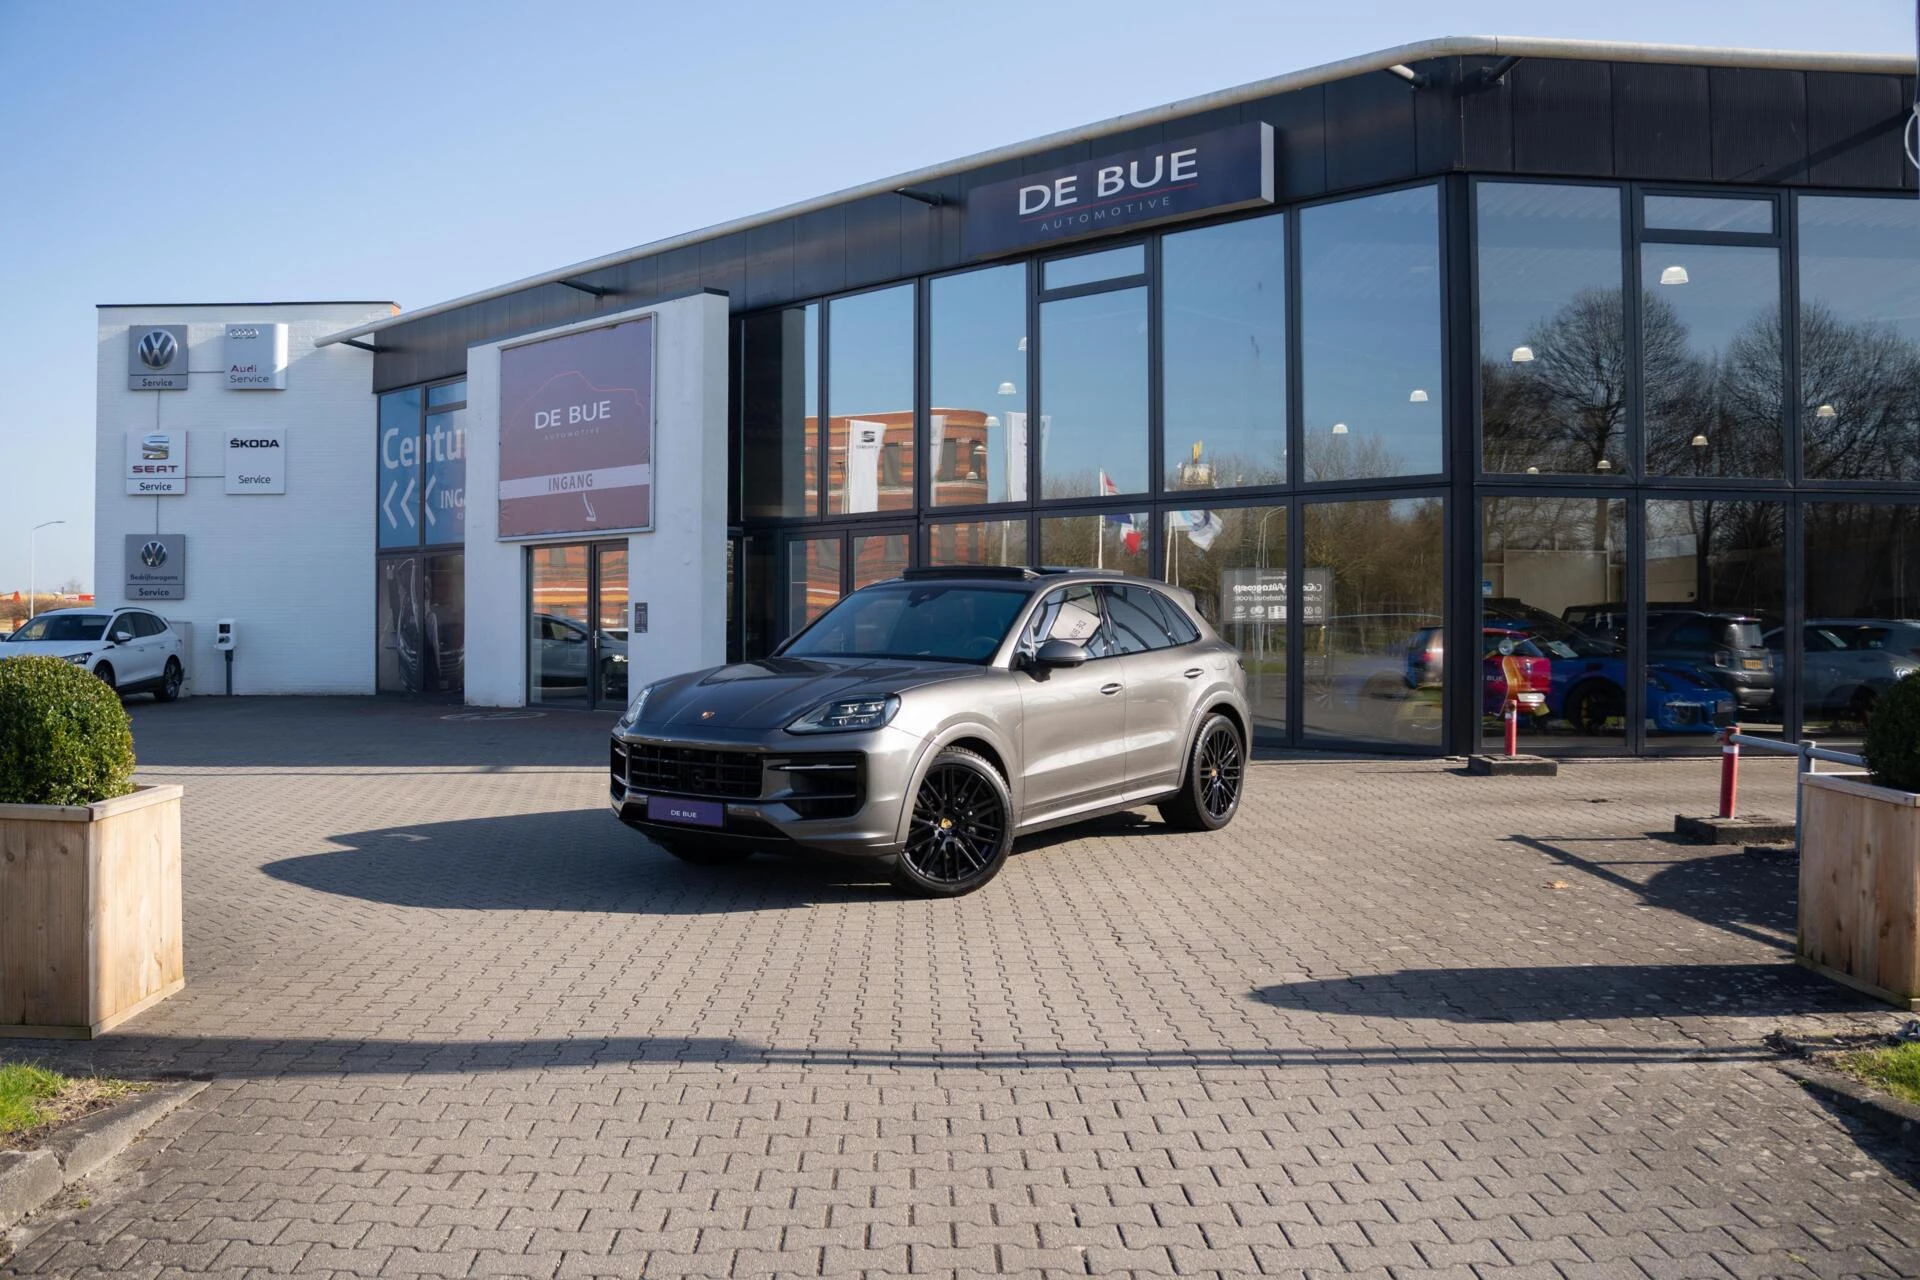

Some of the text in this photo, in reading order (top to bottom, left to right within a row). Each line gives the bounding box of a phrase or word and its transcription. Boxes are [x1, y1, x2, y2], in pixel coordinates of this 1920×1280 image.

[1019, 148, 1198, 216] DE BUE
[1040, 196, 1170, 232] AUTOMOTIVE
[230, 364, 257, 373] Audi
[142, 378, 174, 387] Service
[230, 374, 270, 383] Service
[534, 400, 611, 430] DE BUE
[544, 427, 601, 440] AUTOMOTIVE
[230, 437, 280, 449] ŠKODA
[382, 424, 467, 470] Centu
[132, 465, 178, 473] SEAT
[238, 474, 271, 484] Service
[547, 473, 594, 492] INGANG
[139, 482, 173, 491] Service
[440, 488, 467, 509] ING
[138, 587, 170, 597] Service
[670, 809, 681, 817] DE
